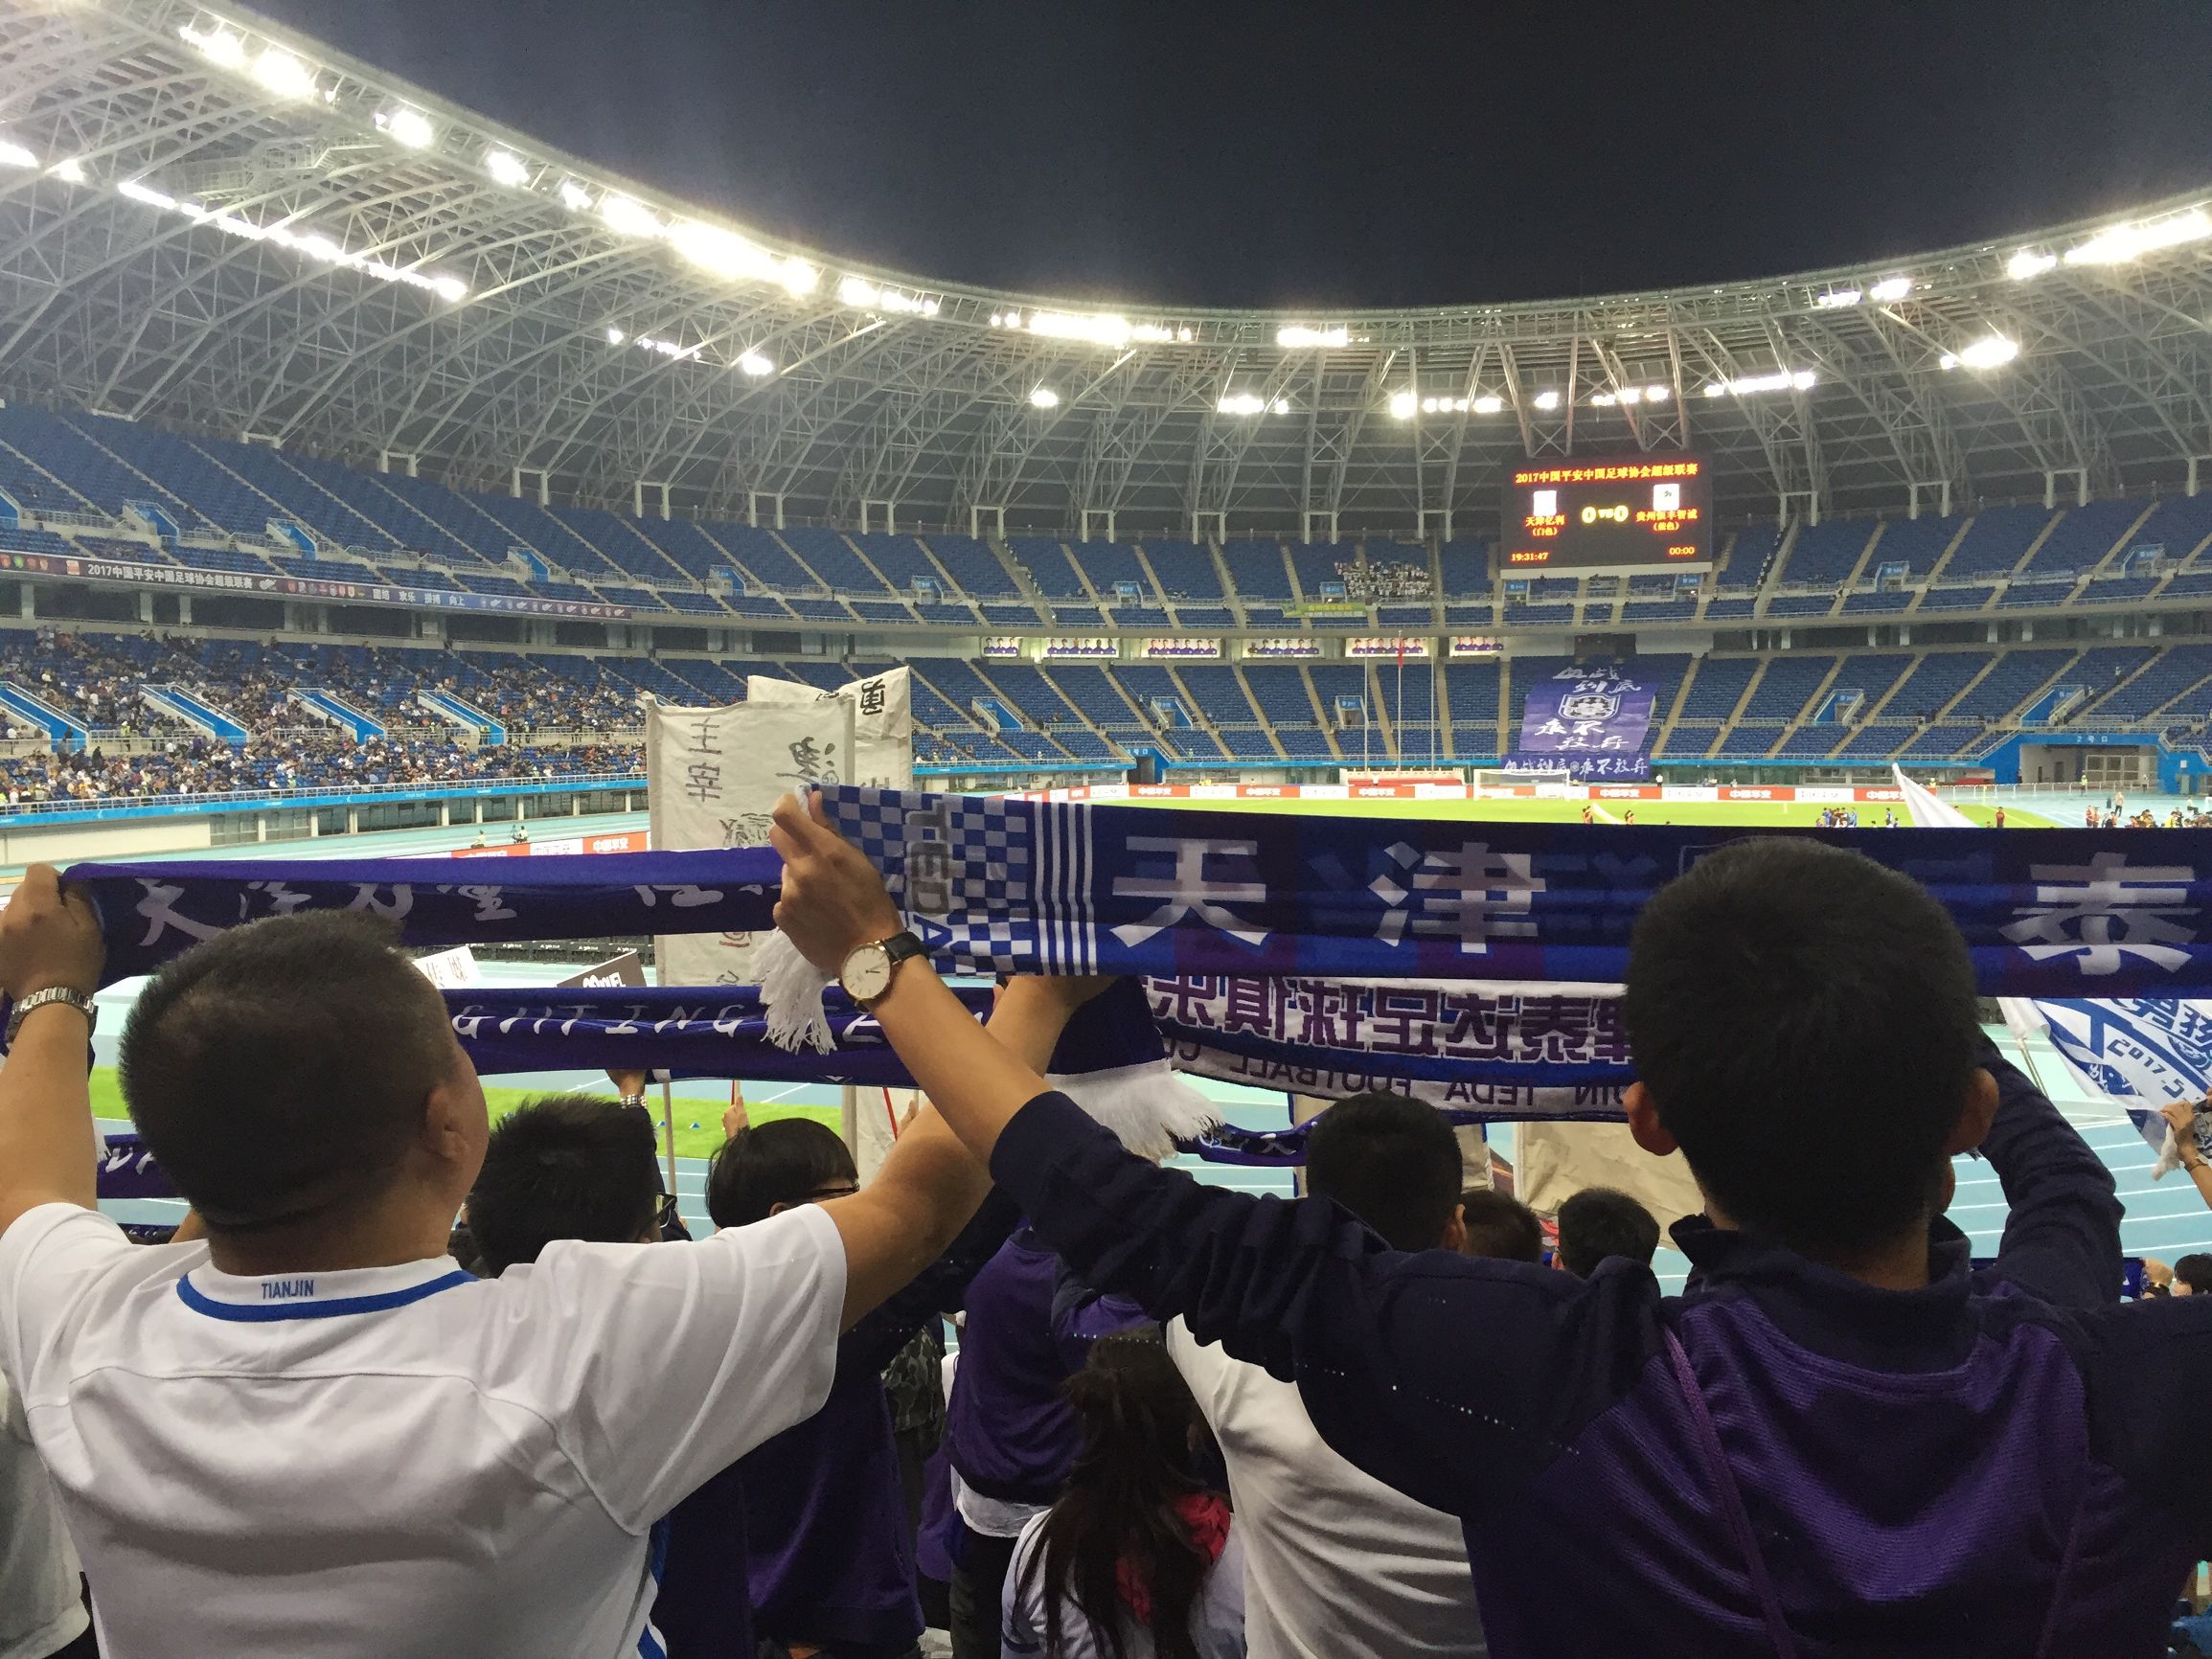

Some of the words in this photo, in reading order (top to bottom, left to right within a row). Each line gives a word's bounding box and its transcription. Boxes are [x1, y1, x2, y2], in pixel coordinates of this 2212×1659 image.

[1582, 507, 1597, 523] 0
[1614, 505, 1629, 522] 0
[1511, 552, 1549, 561] 19:31:47
[1669, 546, 1696, 556] 00:00
[88, 563, 253, 590] 2017中国平安中国足球协会超级联赛
[399, 590, 416, 602] 欢乐
[448, 595, 465, 606] 向上
[1107, 835, 1547, 955] 天津
[1996, 851, 2203, 976] 泰
[261, 1279, 314, 1300] TIANJIN
